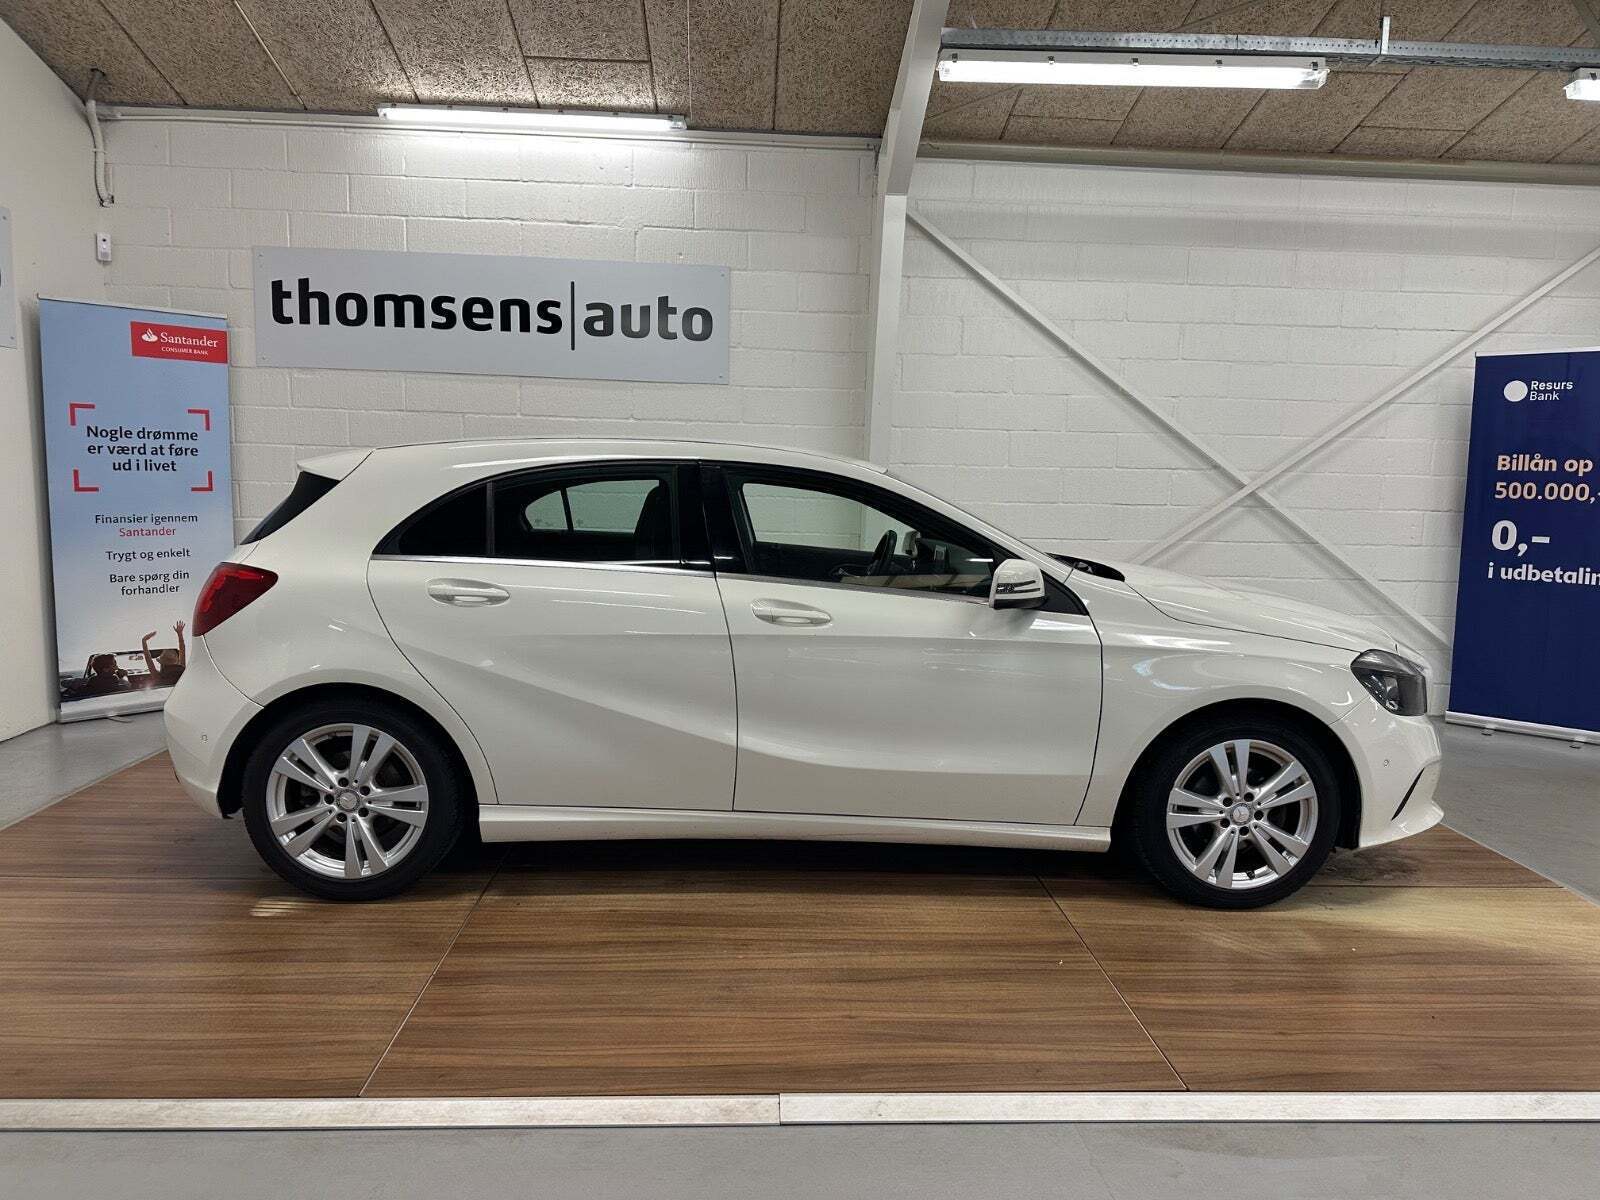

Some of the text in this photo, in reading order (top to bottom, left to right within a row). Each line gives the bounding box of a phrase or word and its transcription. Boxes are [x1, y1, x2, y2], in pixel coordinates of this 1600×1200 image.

[160, 332, 218, 347] Santander
[161, 346, 193, 354] CONSUMER
[1530, 380, 1574, 390] Resurs
[1529, 391, 1560, 401] Bank
[86, 426, 198, 441] Nogle drømme
[87, 441, 199, 458] er værd at føre
[112, 458, 177, 472] ud i livet
[1497, 453, 1593, 477] Billån op
[1494, 481, 1600, 504] 500.000,
[95, 513, 198, 525] Finansier igennem
[119, 527, 176, 537] Santander
[105, 548, 191, 562] Trygt og enkelt
[109, 571, 190, 583] Bare spørg din
[1487, 561, 1494, 579] i
[121, 584, 180, 595] forhandler
